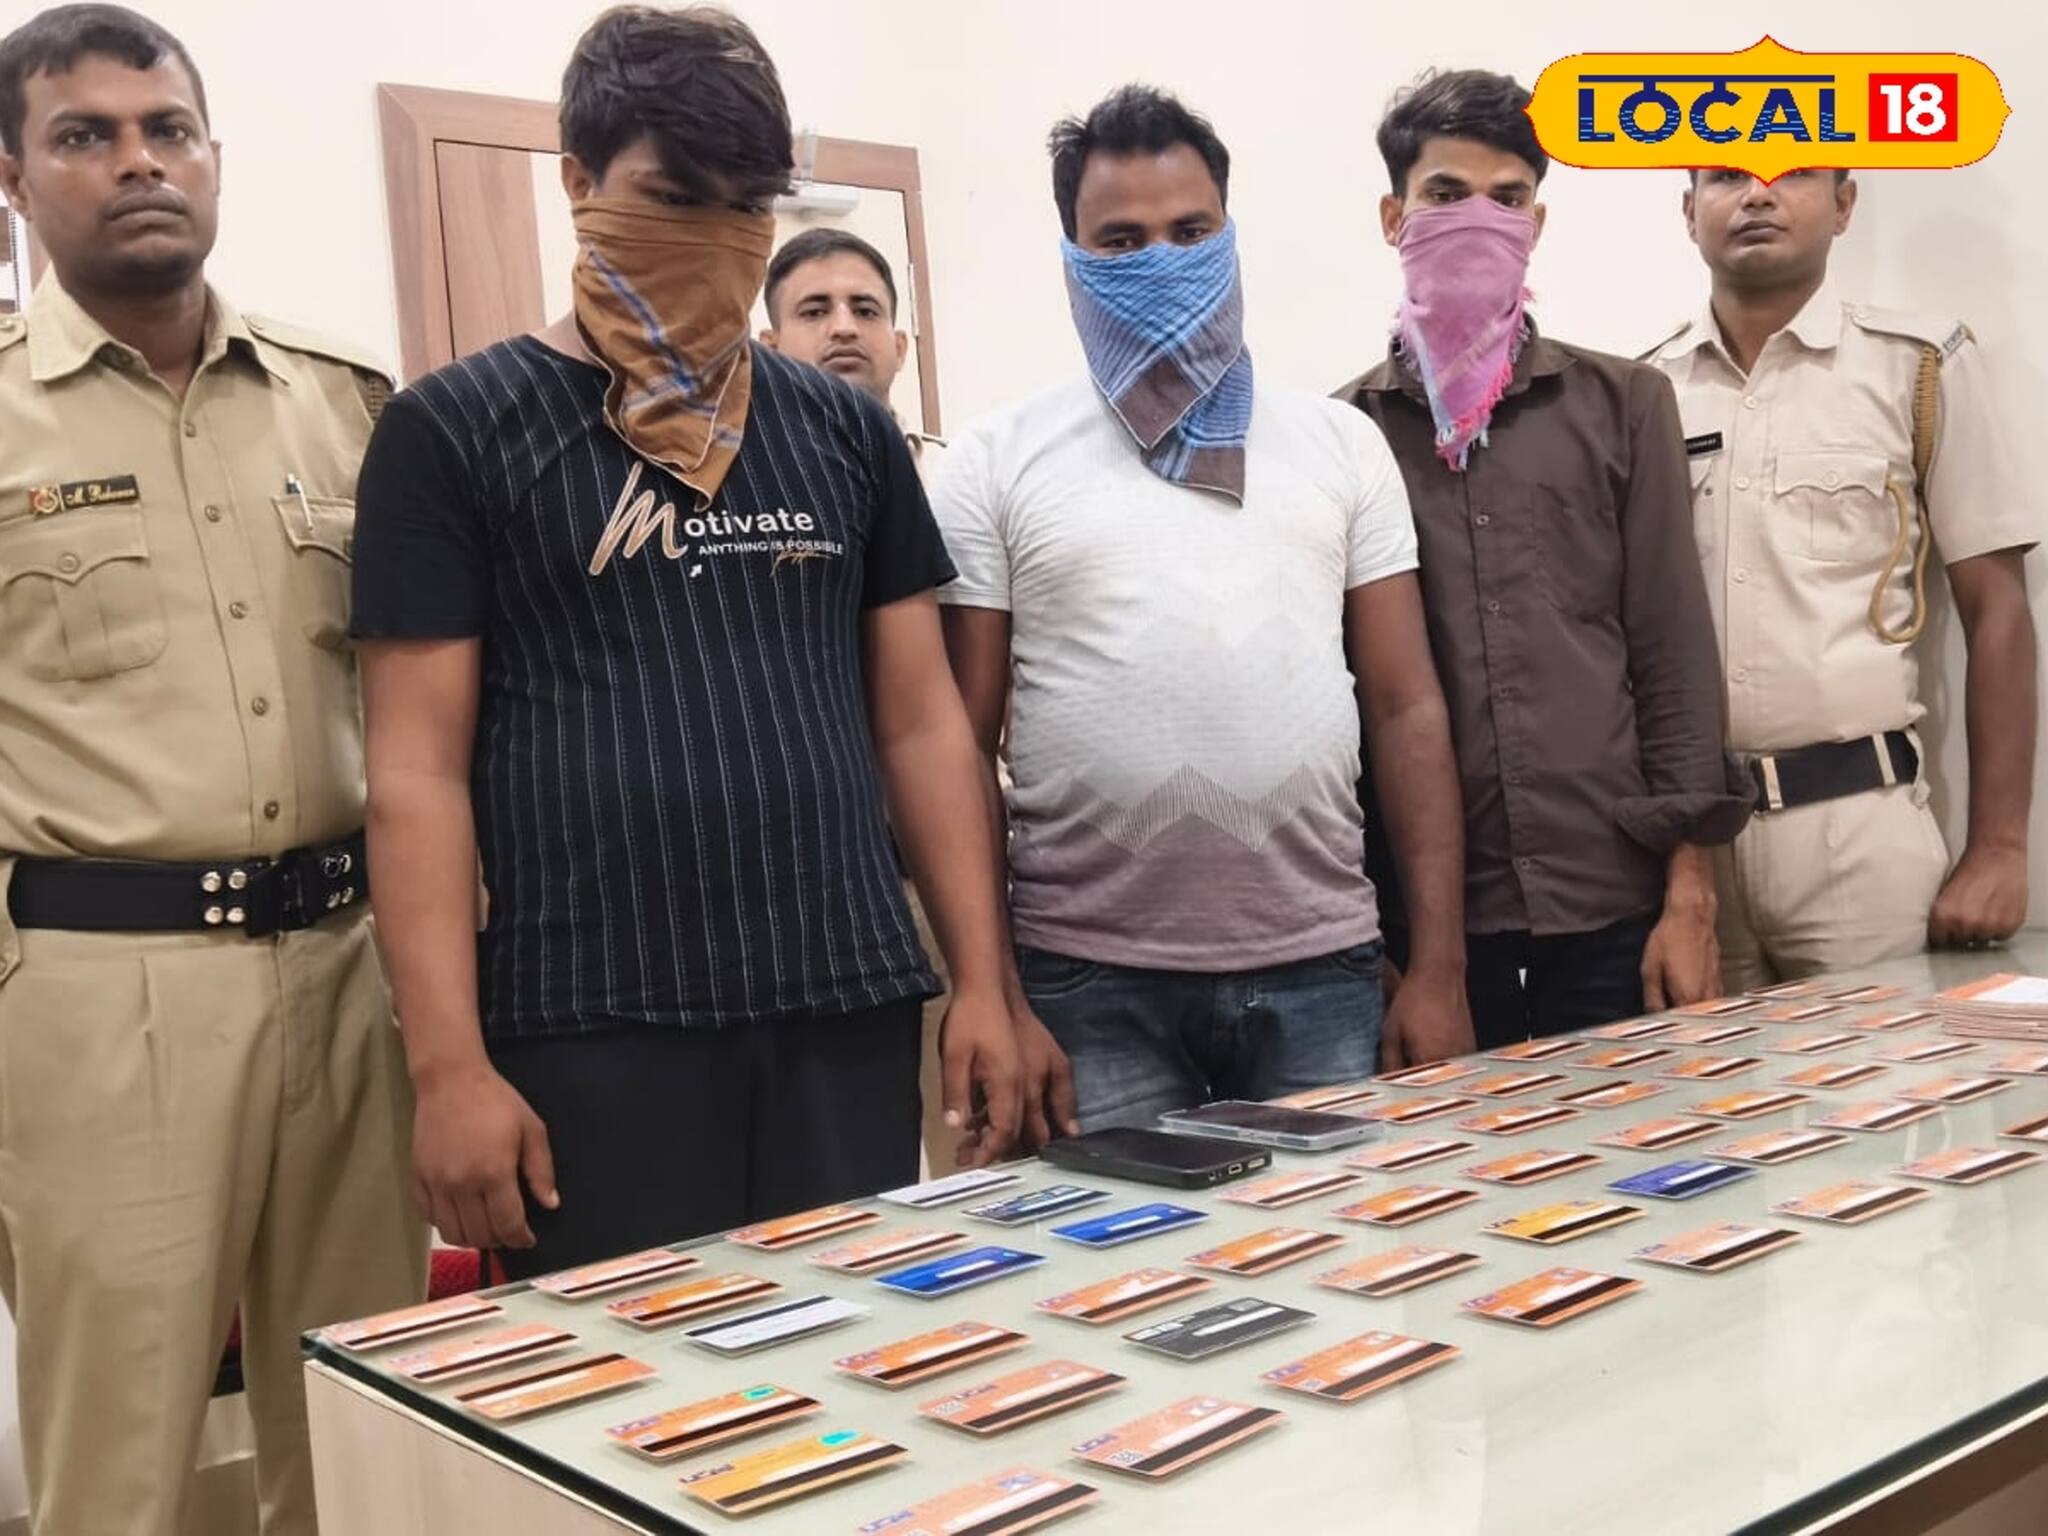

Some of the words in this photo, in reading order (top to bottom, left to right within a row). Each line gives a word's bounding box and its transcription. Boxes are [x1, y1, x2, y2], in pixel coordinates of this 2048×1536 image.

[588, 460, 815, 577] Motivate
[699, 540, 768, 556] ANYTHING
[786, 539, 844, 555] POSSIBLE
